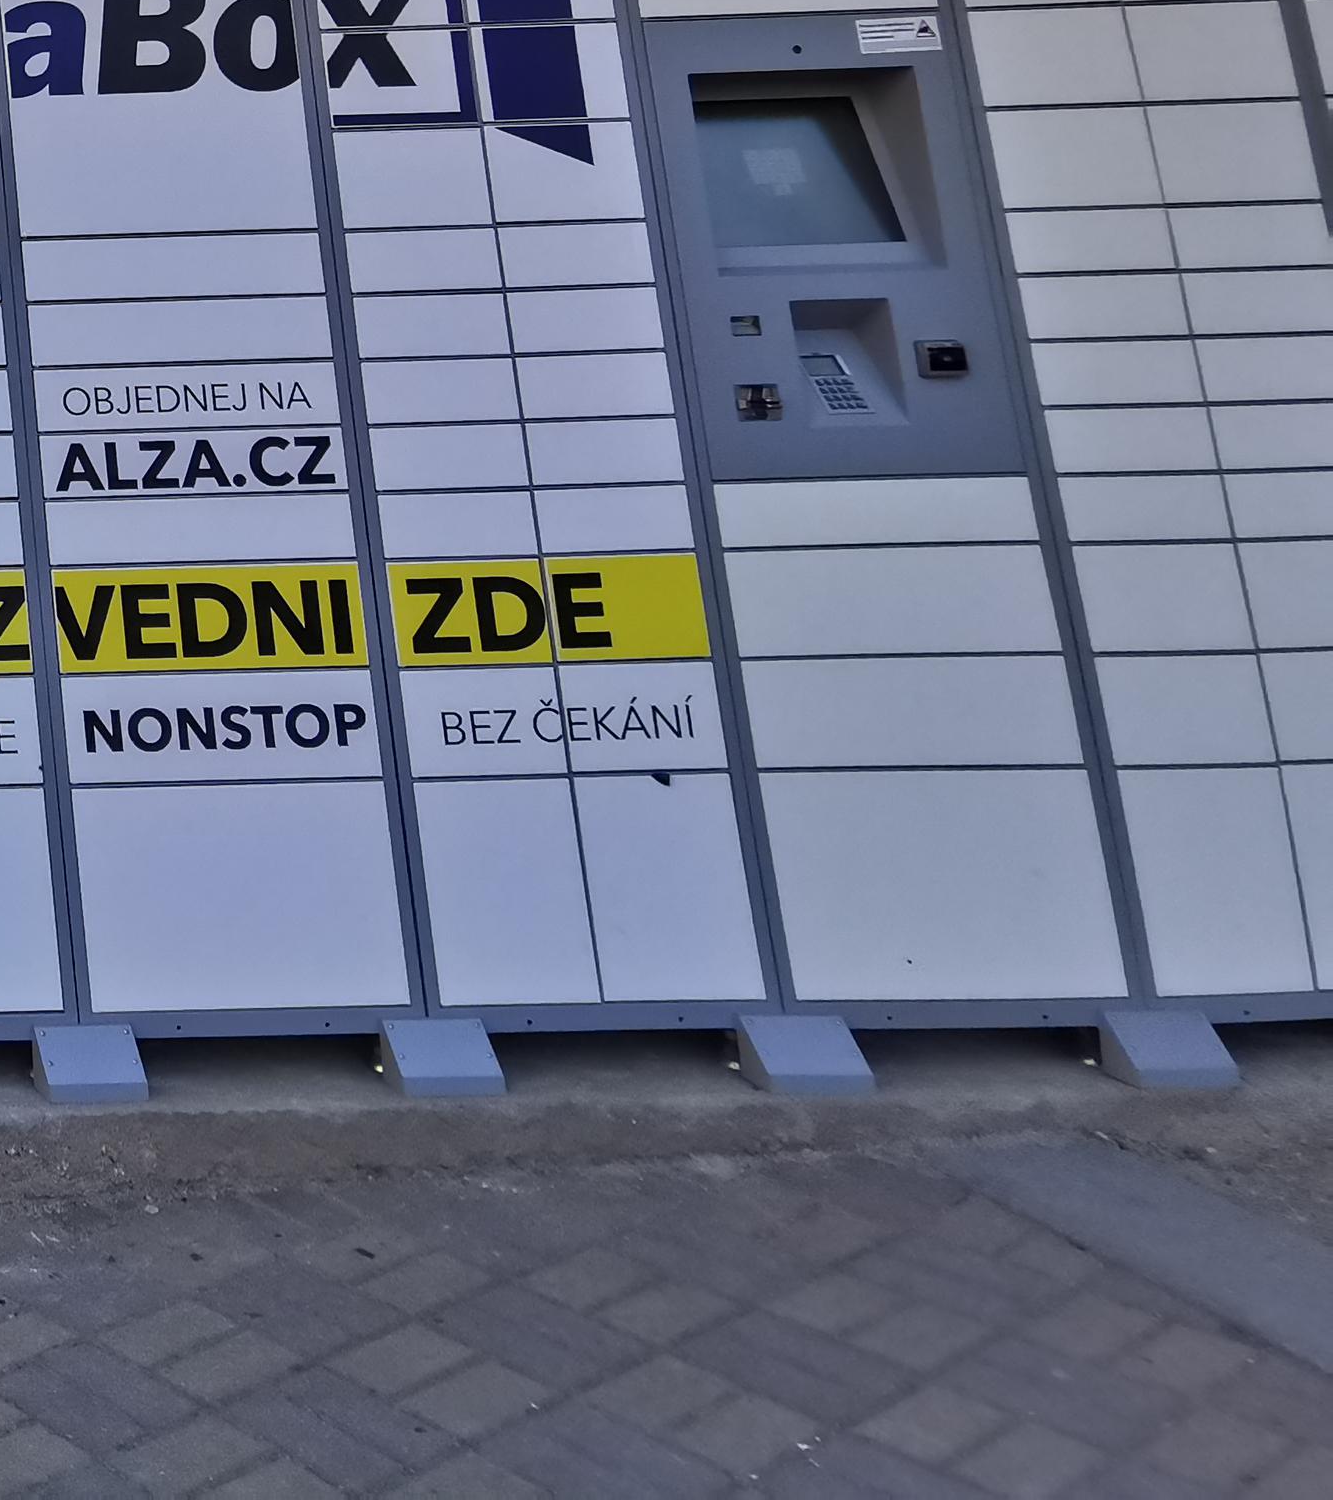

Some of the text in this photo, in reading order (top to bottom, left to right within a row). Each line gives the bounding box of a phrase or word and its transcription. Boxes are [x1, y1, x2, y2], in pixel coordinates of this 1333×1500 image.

[62, 381, 313, 417] OBJEDNEJ NA
[55, 435, 337, 493] ALZA.CZ
[405, 572, 614, 655] ZDE
[82, 702, 368, 755] NONSTOP
[440, 708, 522, 746] BEZ
[532, 694, 696, 743] ČEKÁNÍ
